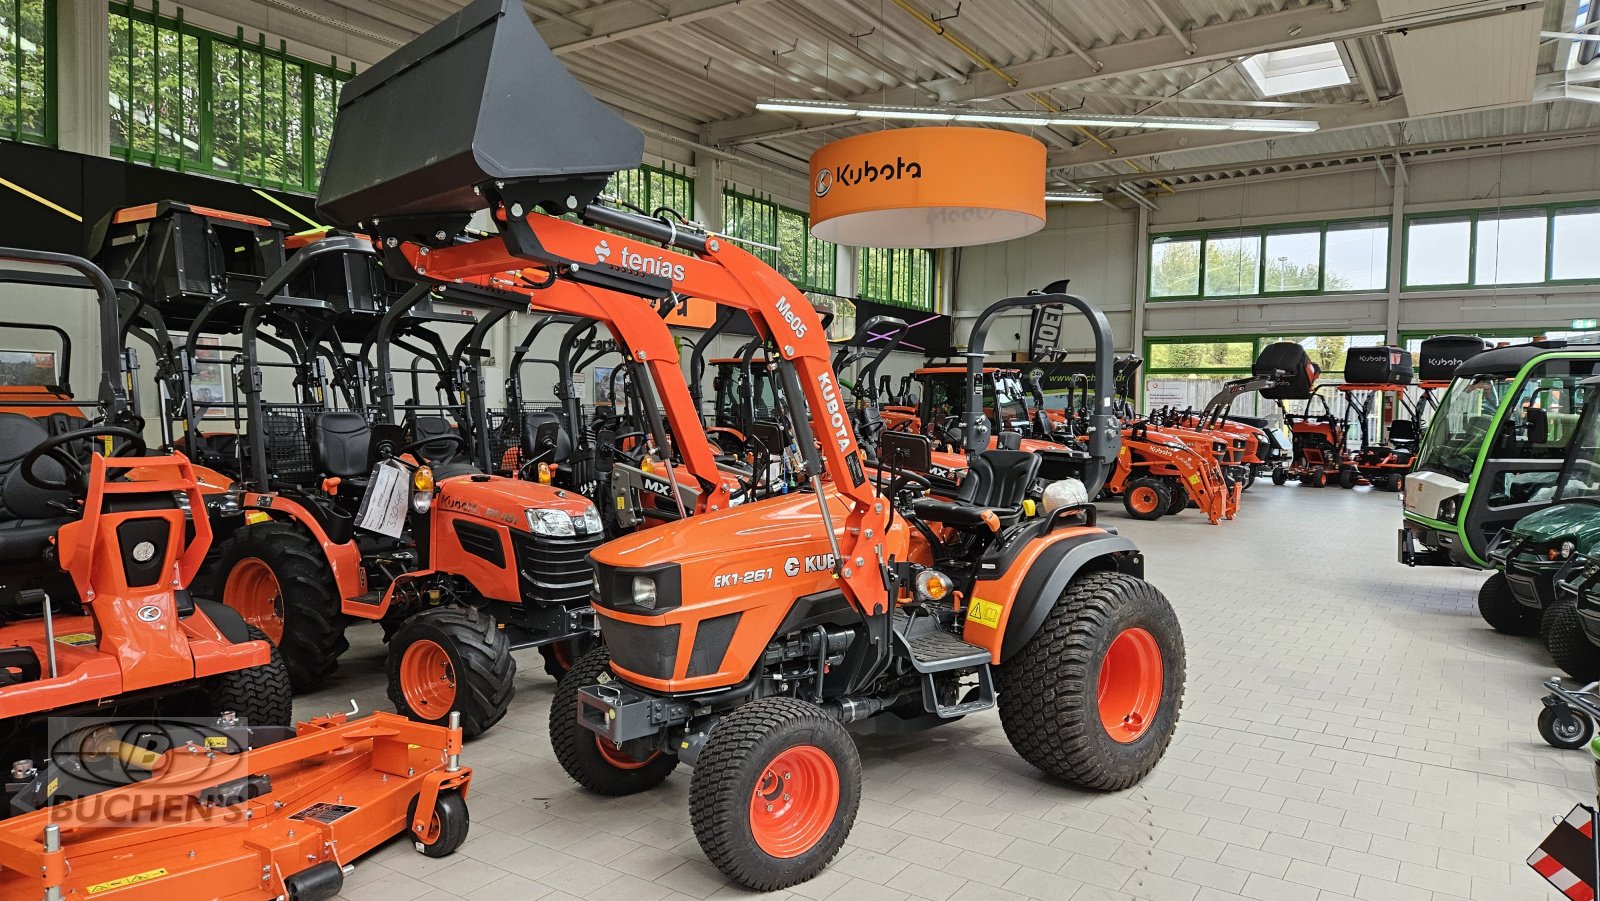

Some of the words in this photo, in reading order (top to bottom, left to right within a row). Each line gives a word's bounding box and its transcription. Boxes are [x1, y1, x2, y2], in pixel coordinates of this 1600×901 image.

[836, 157, 922, 187] Kubota
[621, 246, 686, 281] tenías
[775, 296, 808, 340] Me05
[1359, 354, 1387, 363] Kubota
[1428, 357, 1463, 366] Kubota
[817, 371, 851, 453] KUBOTA
[644, 478, 670, 496] MX
[805, 553, 836, 573] KUB
[713, 567, 773, 588] EK1-261
